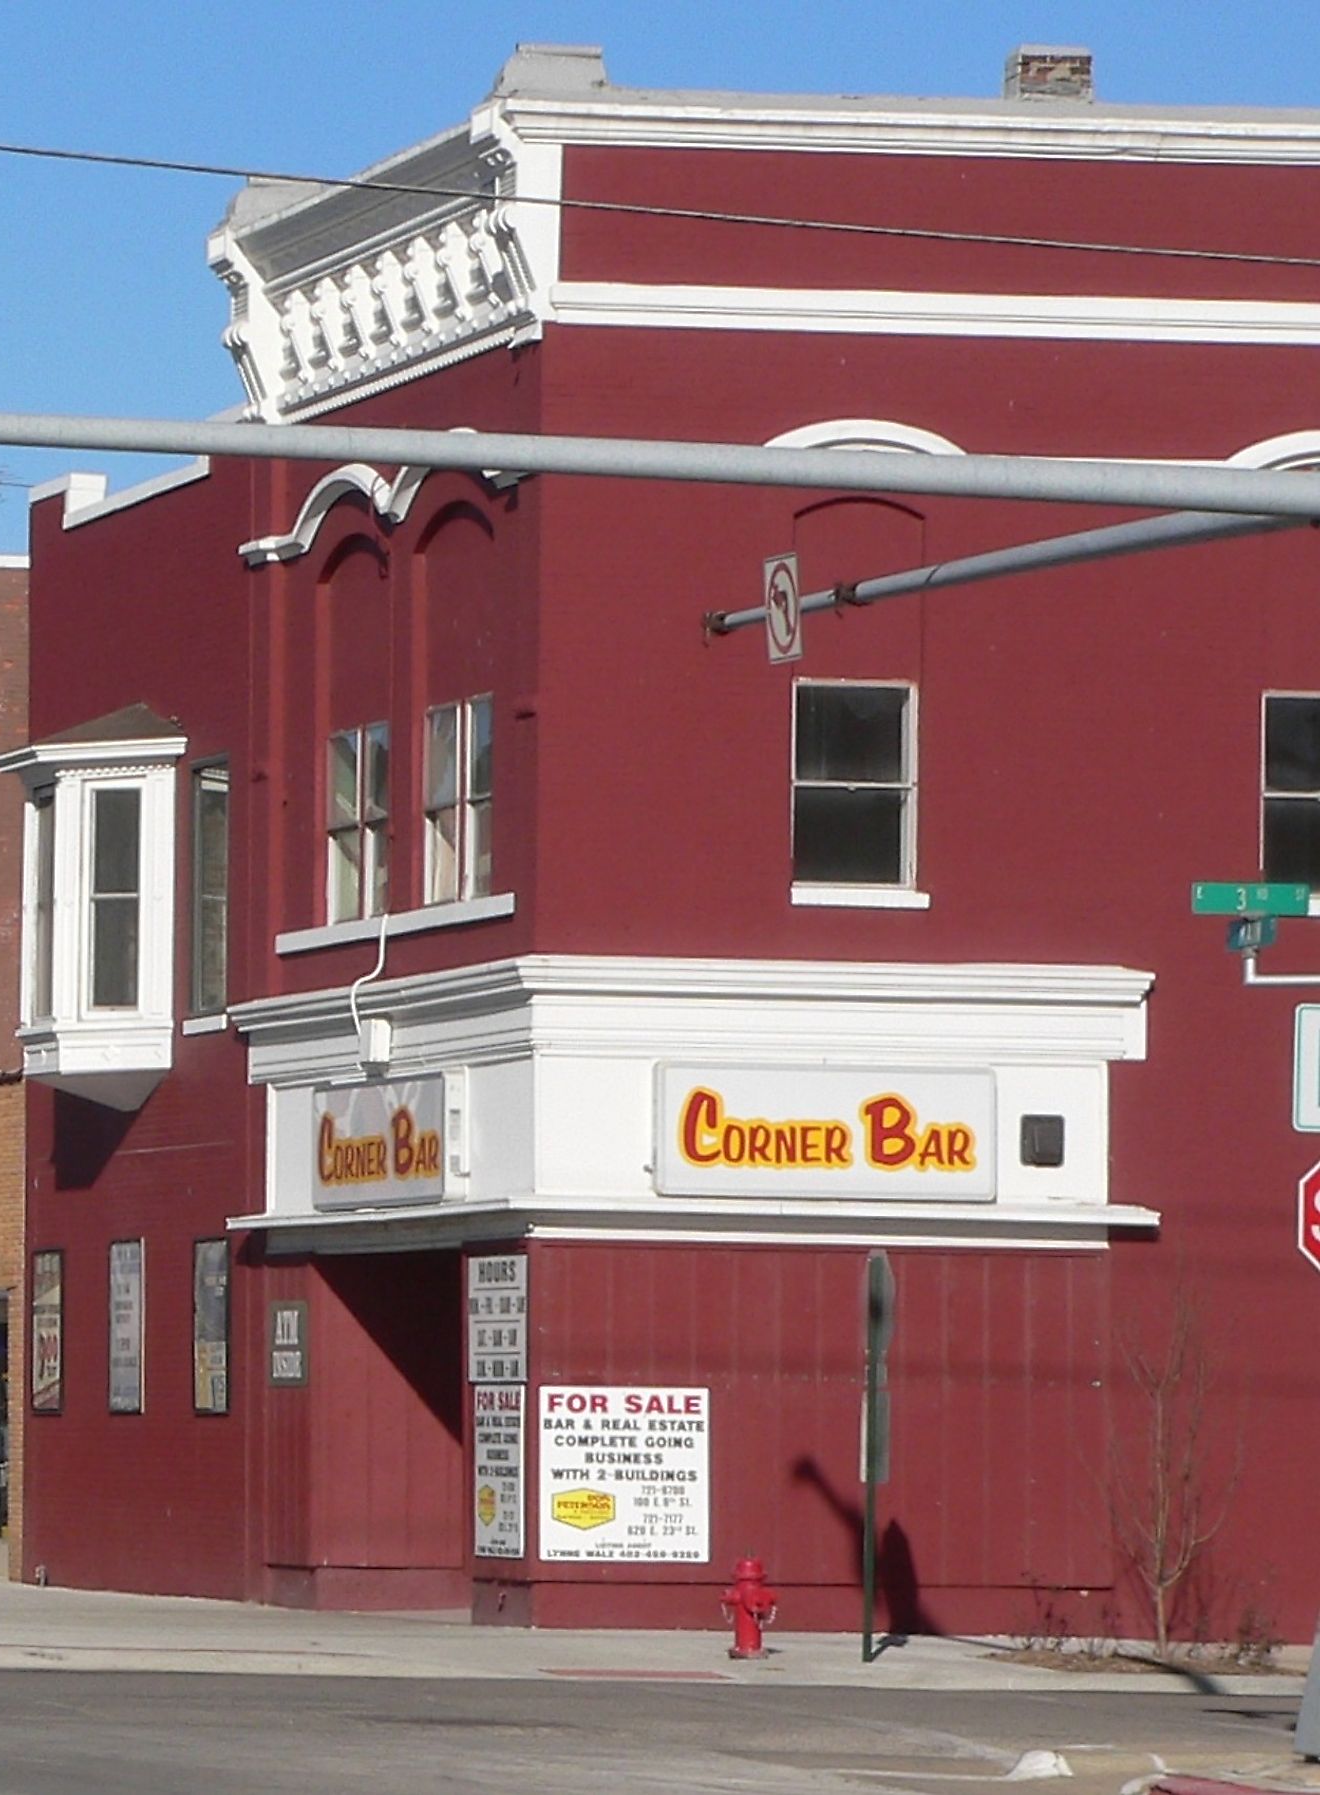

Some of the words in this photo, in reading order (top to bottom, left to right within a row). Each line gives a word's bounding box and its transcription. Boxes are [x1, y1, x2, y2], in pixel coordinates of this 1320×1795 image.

[682, 1089, 850, 1166] CORNER
[862, 1094, 975, 1169] BAR
[317, 1112, 388, 1186] CORNER
[390, 1105, 440, 1179] BAR
[478, 1261, 516, 1283] HOURS
[275, 1311, 299, 1345] ATM
[477, 1391, 494, 1411] FOR
[498, 1391, 520, 1411] SALE
[547, 1393, 609, 1413] FOR
[624, 1395, 702, 1415] SALE
[543, 1419, 575, 1430] BAR
[582, 1419, 593, 1430] &
[601, 1419, 641, 1431] REAL
[648, 1420, 705, 1432] ESTATE
[554, 1435, 638, 1448] COMPLETE
[644, 1436, 694, 1449] GOING
[584, 1452, 663, 1464] BUSINESS
[551, 1469, 589, 1480] WITH
